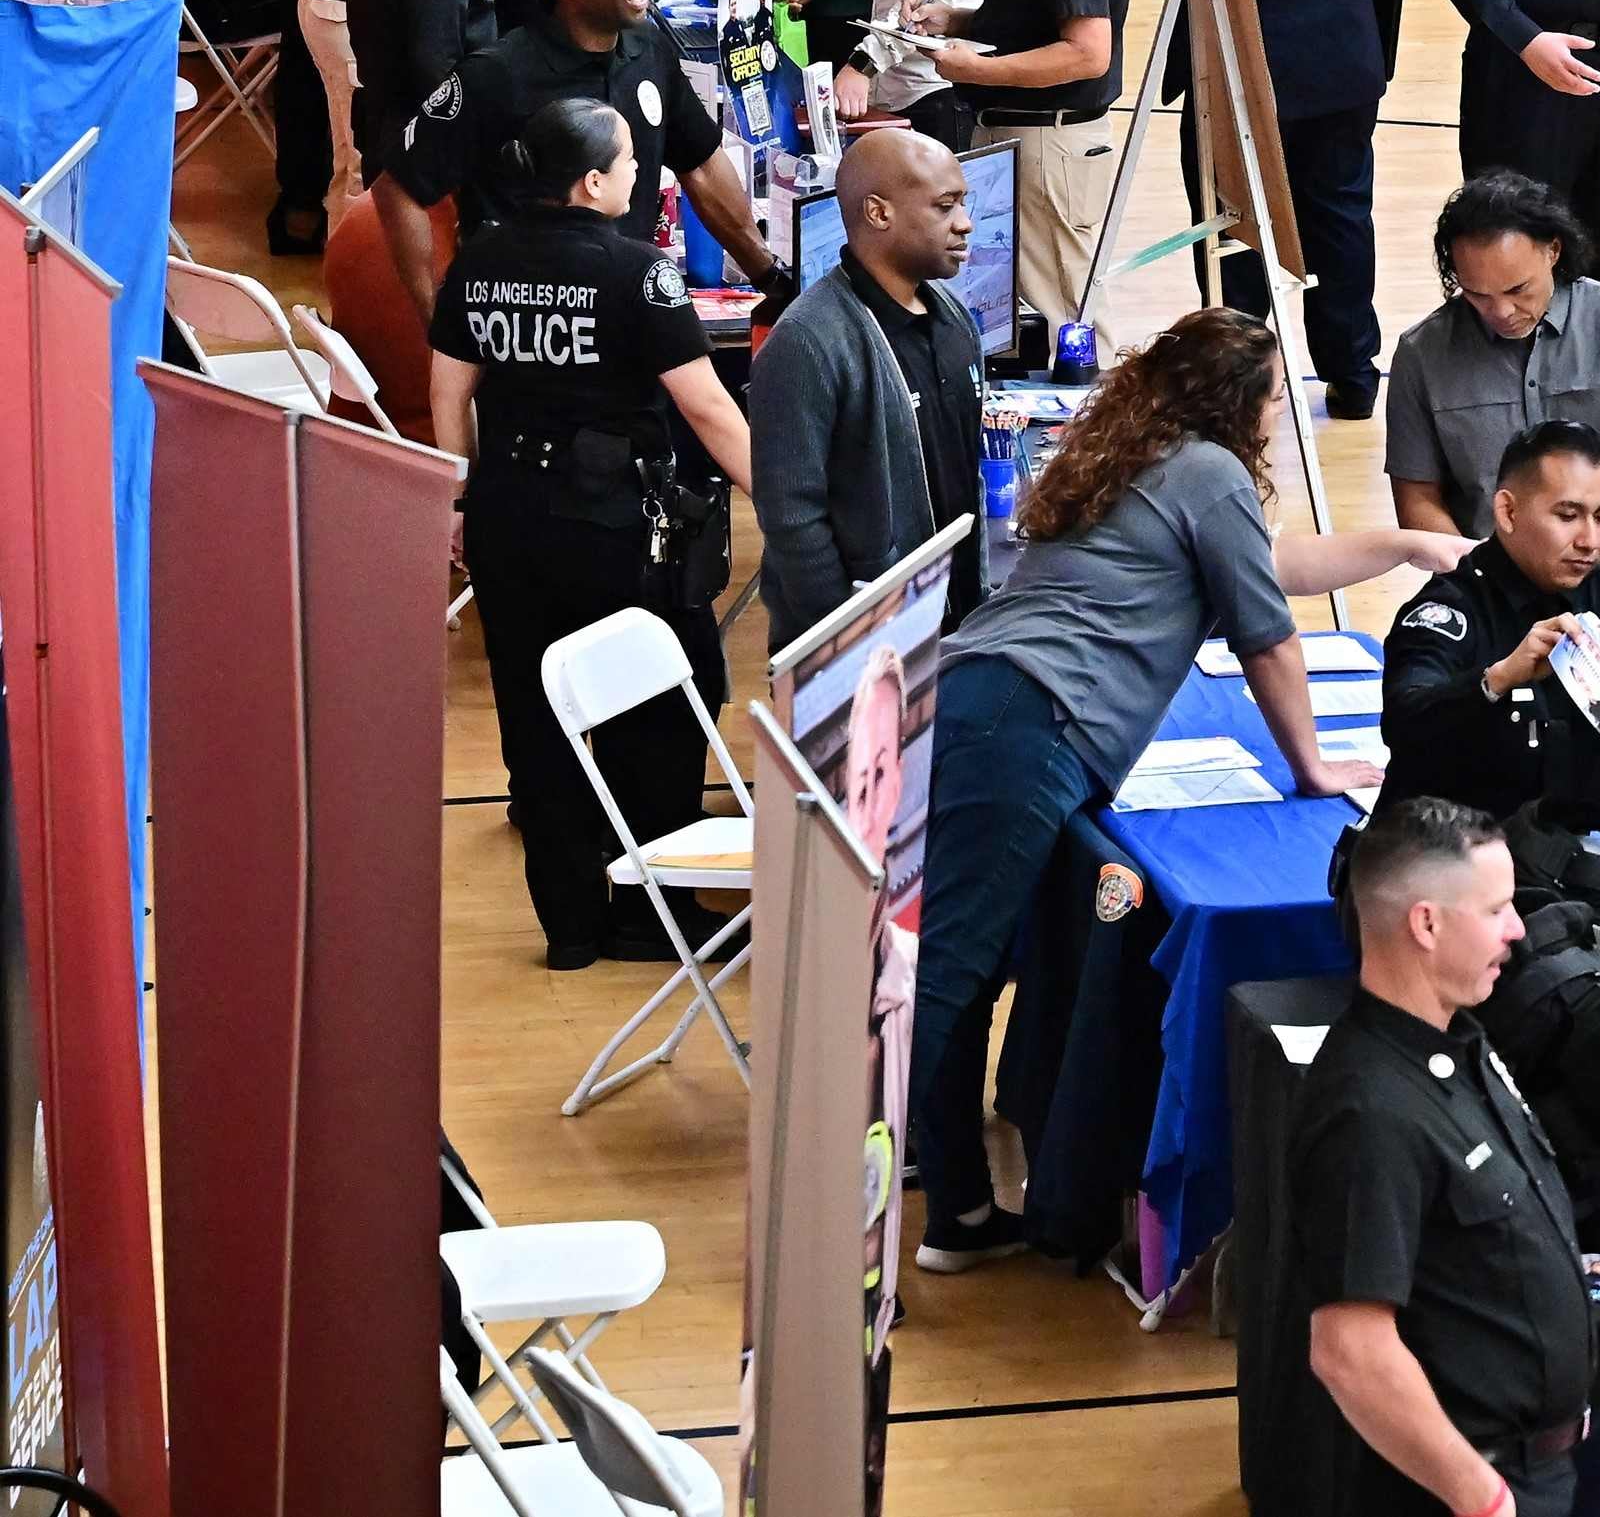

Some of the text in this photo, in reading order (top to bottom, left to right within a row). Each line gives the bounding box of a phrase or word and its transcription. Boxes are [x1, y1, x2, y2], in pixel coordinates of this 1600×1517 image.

[729, 43, 761, 68] SECURITY
[465, 280, 598, 310] LOS ANGELES PORT
[467, 310, 600, 366] POLICE
